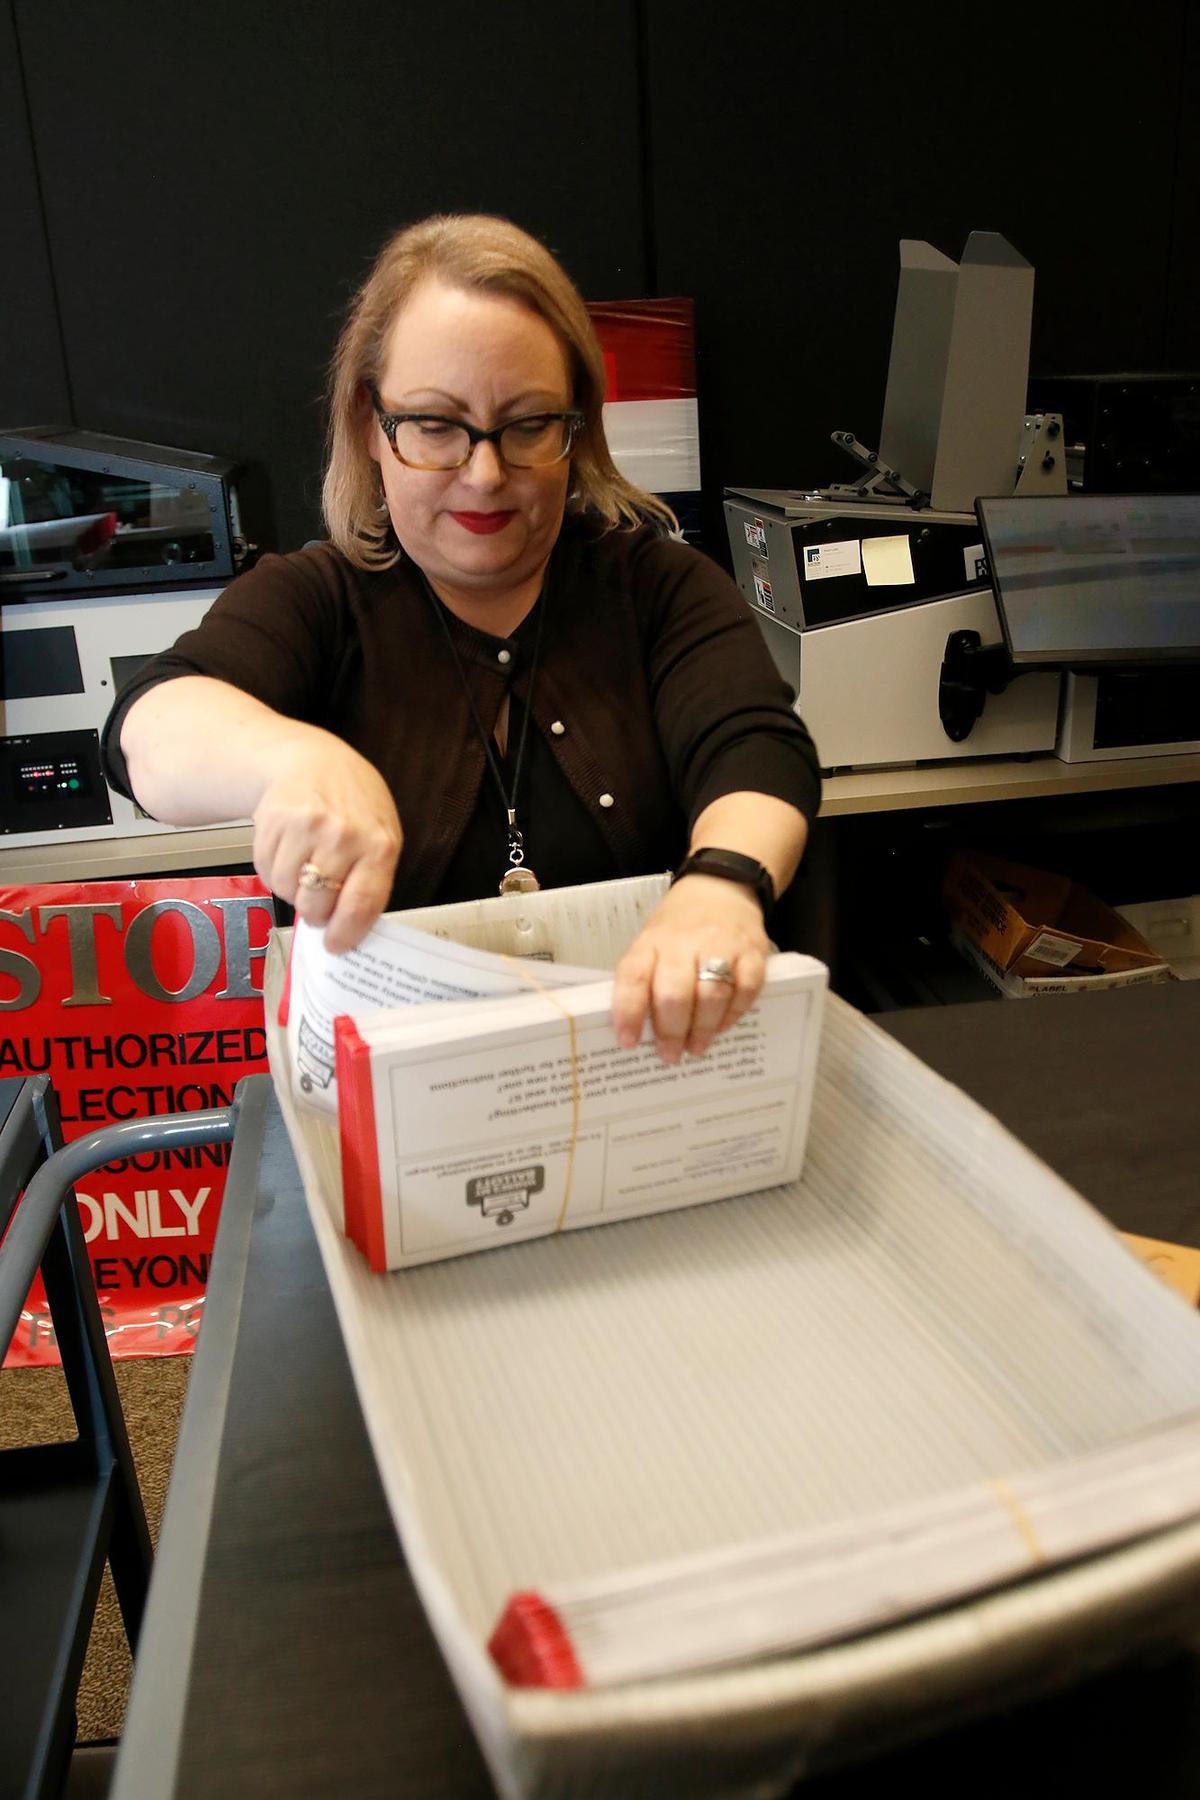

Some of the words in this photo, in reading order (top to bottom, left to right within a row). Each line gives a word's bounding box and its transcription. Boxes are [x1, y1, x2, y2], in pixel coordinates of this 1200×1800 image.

[0, 1027, 267, 1071] AUTHORIZED
[54, 1082, 236, 1122] LECTION
[95, 1253, 213, 1291] EYON
